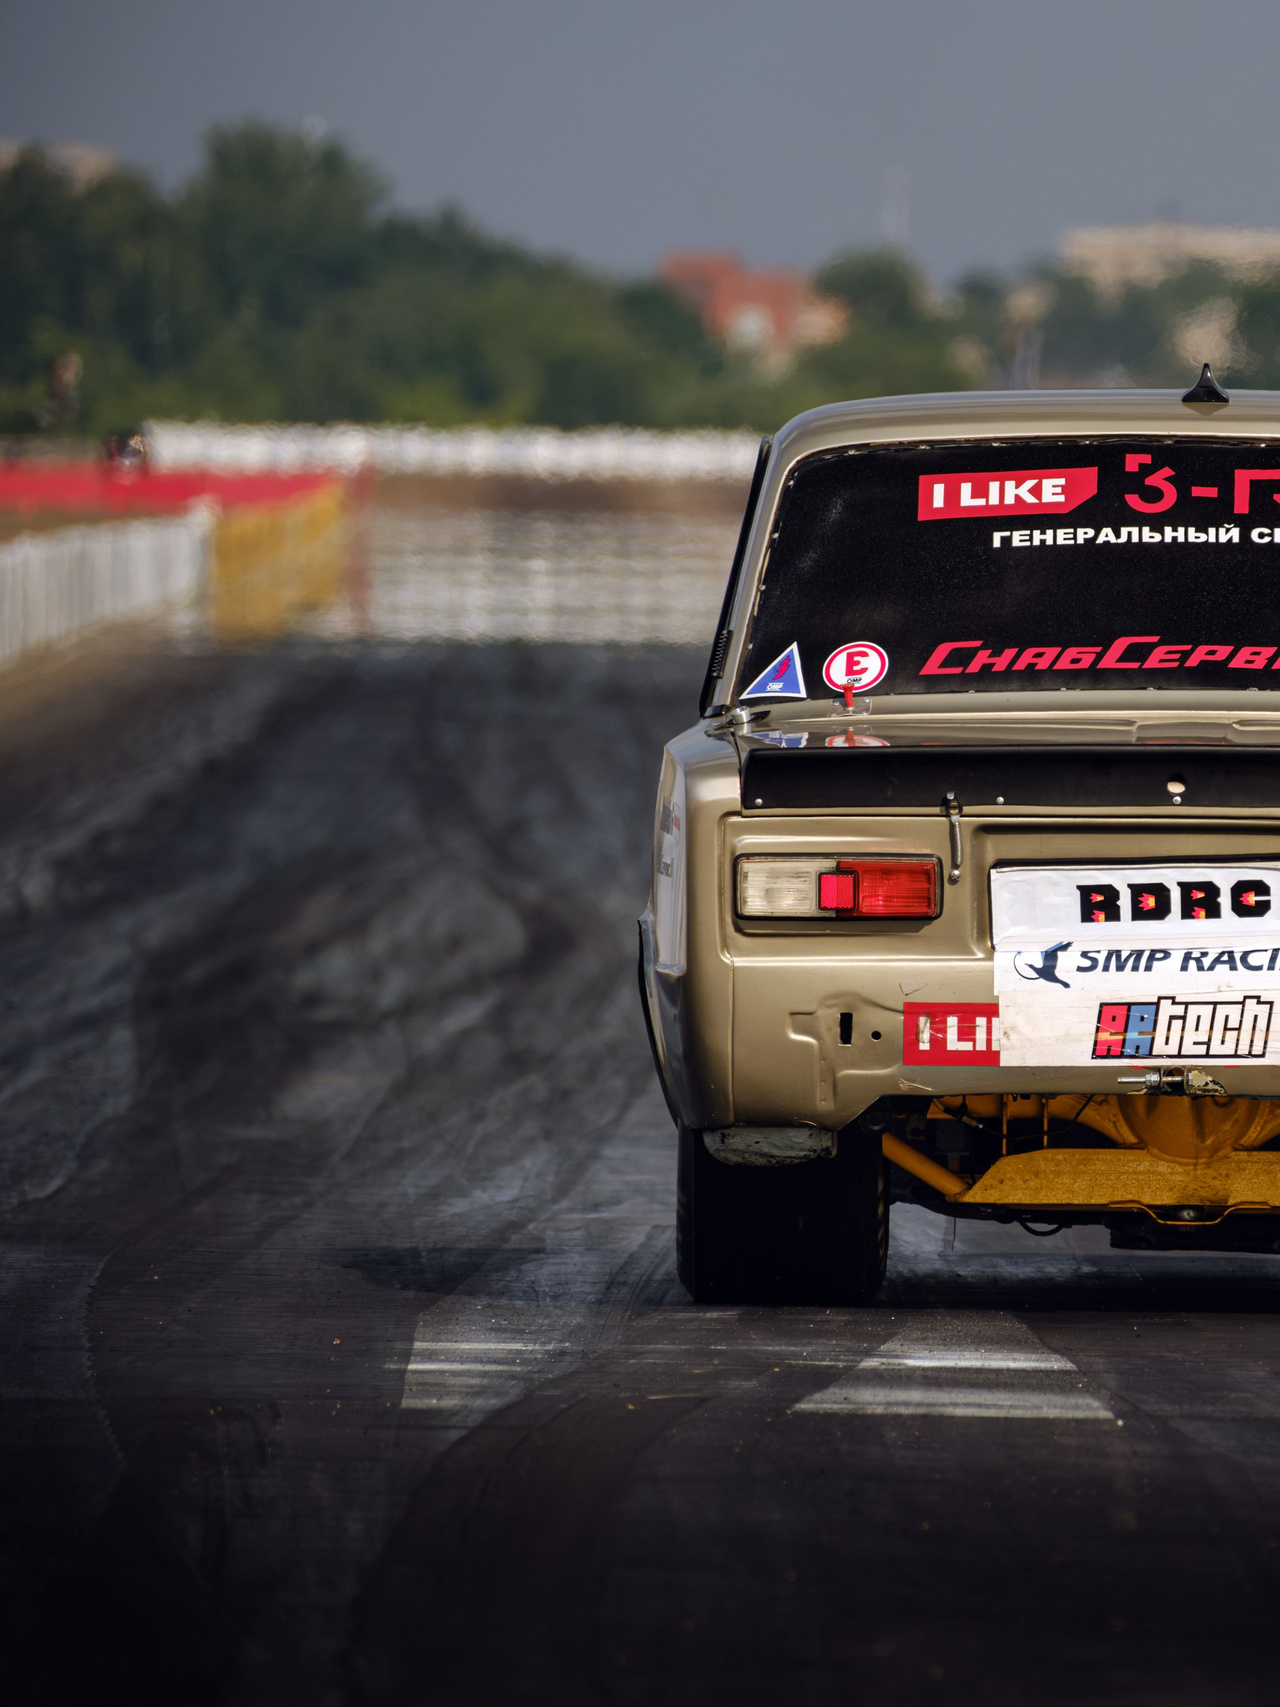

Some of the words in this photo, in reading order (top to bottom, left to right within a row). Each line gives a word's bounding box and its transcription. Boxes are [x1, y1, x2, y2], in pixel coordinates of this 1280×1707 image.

[933, 480, 945, 508] I
[959, 477, 1066, 506] LIKE
[992, 525, 1241, 548] ГЕНЕРАЛЬНЫЙ
[845, 650, 870, 677] E
[1076, 879, 1272, 923] RDRC
[1077, 948, 1172, 973] SMP
